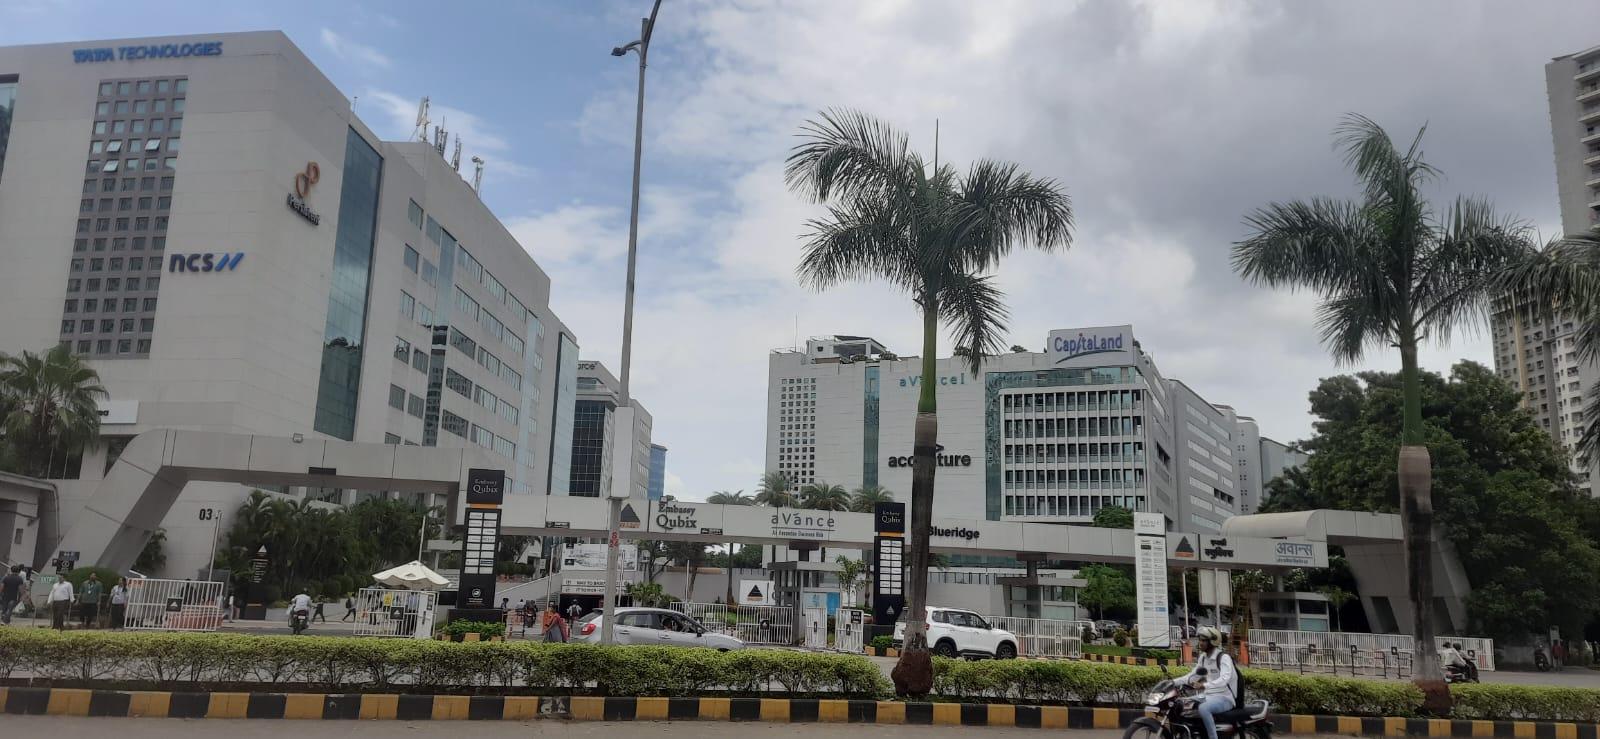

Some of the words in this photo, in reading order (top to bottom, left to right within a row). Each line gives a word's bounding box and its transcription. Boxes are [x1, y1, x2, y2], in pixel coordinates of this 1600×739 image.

[73, 47, 115, 63] TATA
[118, 42, 223, 60] TECHNOLOGIES
[1054, 333, 1123, 355] CapitaLand
[888, 453, 971, 468] accture
[199, 508, 213, 521] 03
[658, 503, 696, 516] Embassy
[656, 514, 697, 530] Qubix
